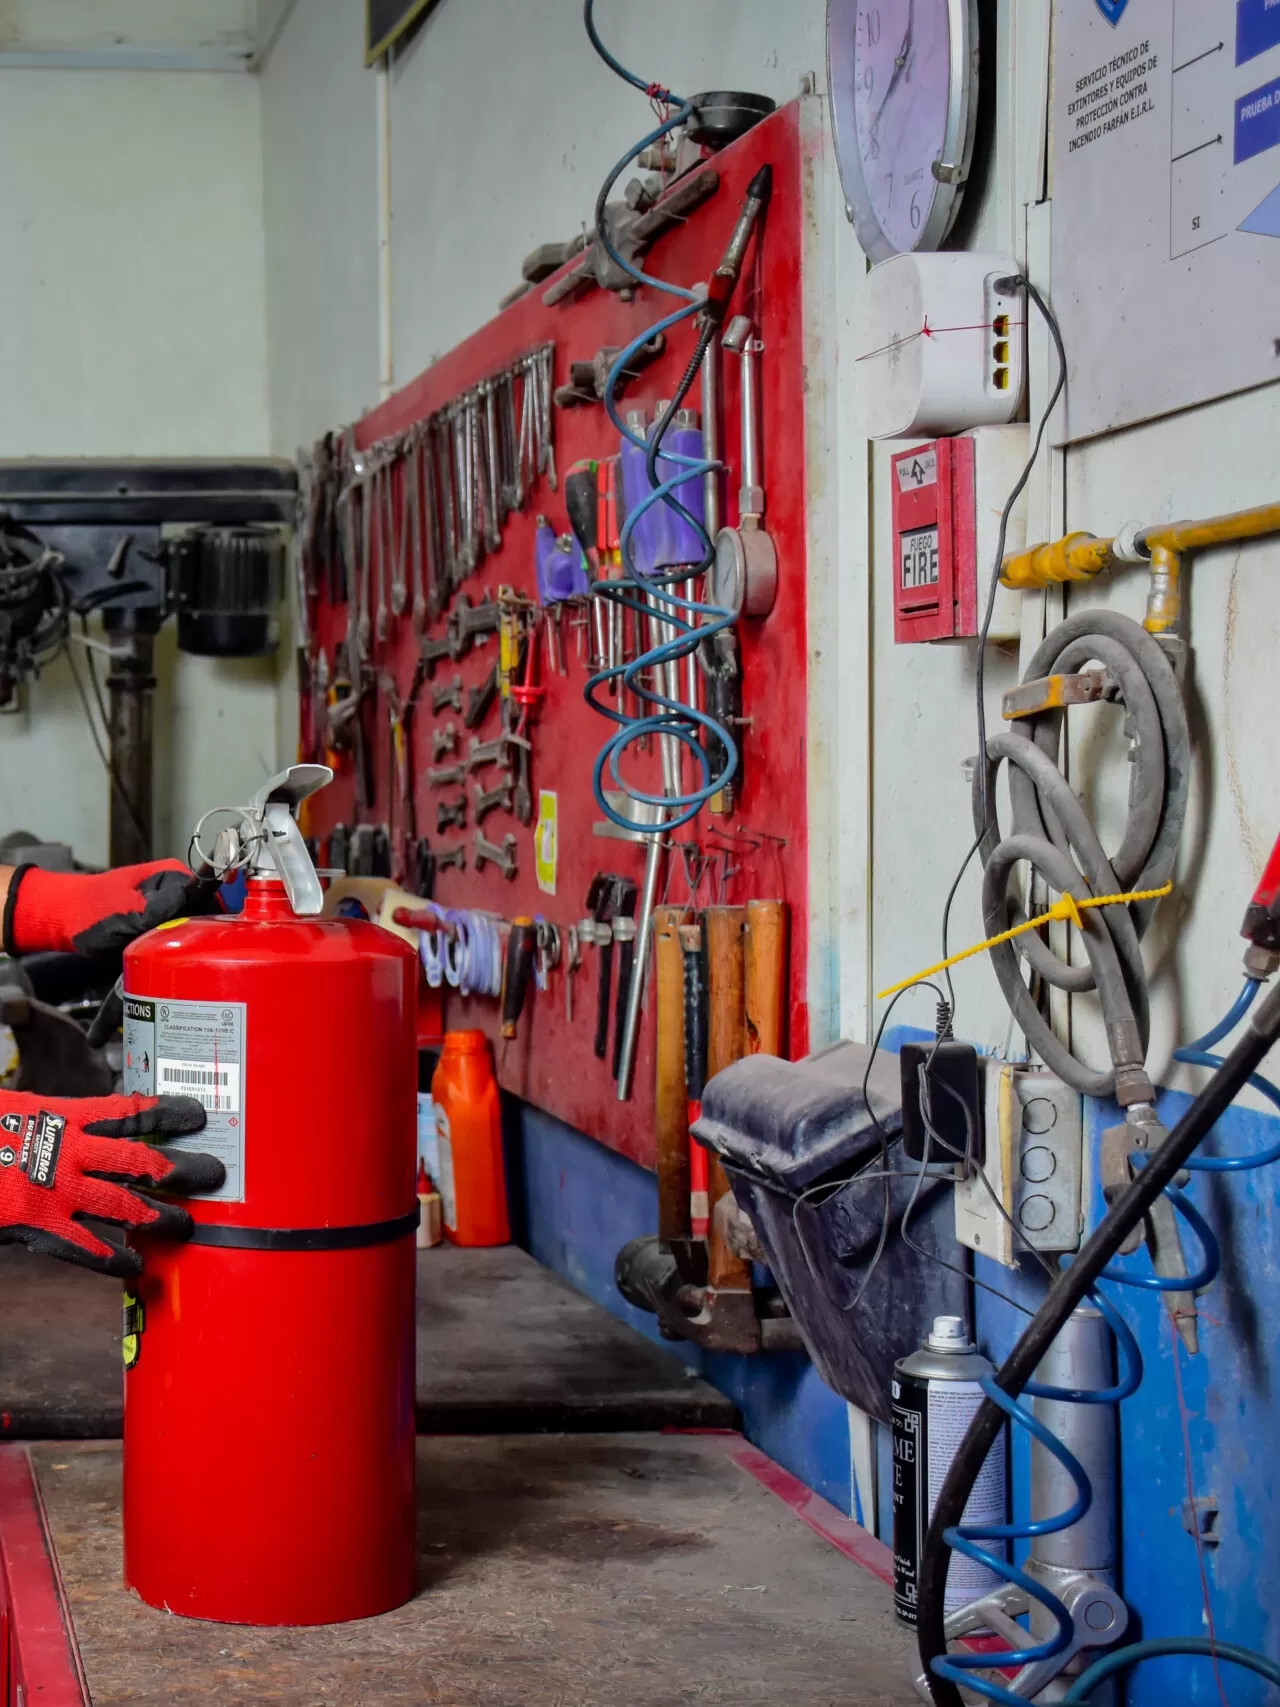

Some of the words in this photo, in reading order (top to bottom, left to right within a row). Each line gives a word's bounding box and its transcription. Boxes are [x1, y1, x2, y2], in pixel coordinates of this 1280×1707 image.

[867, 8, 880, 47] 10
[864, 66, 874, 103] 9
[1067, 83, 1108, 116] EXTINTORES
[1109, 79, 1115, 93] Y
[1115, 61, 1147, 90] EQUIPOS
[1148, 55, 1158, 72] DE
[1075, 65, 1108, 93] SERVICIO
[1108, 46, 1139, 75] TÉCNICO
[1140, 40, 1150, 57] DE
[1076, 96, 1119, 131] PROTECCIÓN
[1119, 81, 1148, 107] CONTRA
[1240, 93, 1273, 122] PRUEBA
[1068, 126, 1102, 153] INCENDIO
[1103, 109, 1129, 135] FARFÁN
[884, 172, 893, 209] 7
[910, 189, 920, 230] 6
[1191, 215, 1201, 231] SI
[910, 534, 933, 552] FUEGO
[903, 548, 938, 588] FIRE
[164, 1024, 203, 1032] CLASSIFICATION
[0, 1151, 14, 1162] 9
[38, 1115, 61, 1182] SUPREMO
